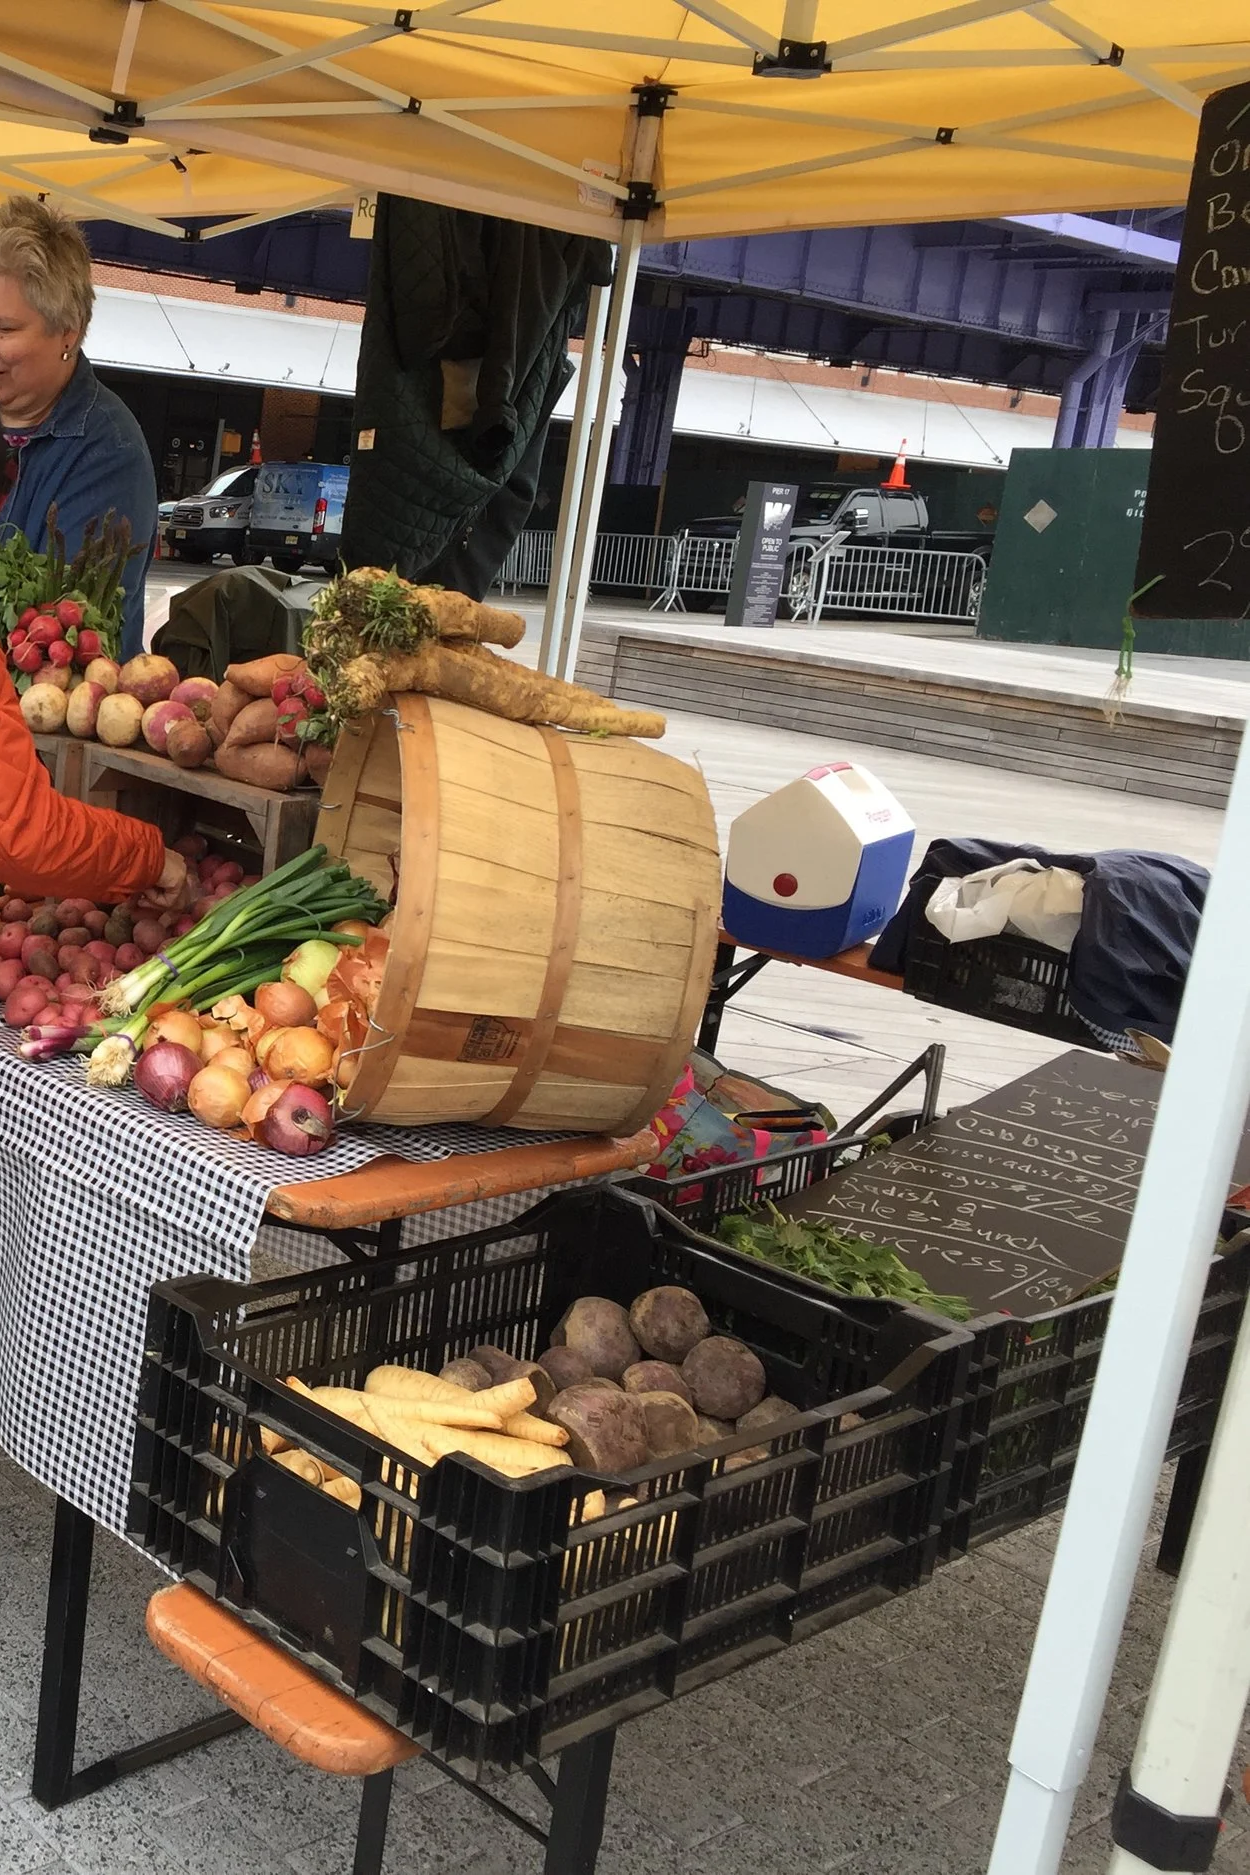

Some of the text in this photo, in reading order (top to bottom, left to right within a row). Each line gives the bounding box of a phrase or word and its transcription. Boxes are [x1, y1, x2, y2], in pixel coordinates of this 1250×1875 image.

[772, 487, 784, 495] PIER
[761, 537, 783, 546] OPEN TO
[955, 1117, 1103, 1166] Cabbage
[866, 1156, 1000, 1189] Asparagus
[841, 1176, 941, 1207] Radish
[827, 1194, 897, 1219] Kale
